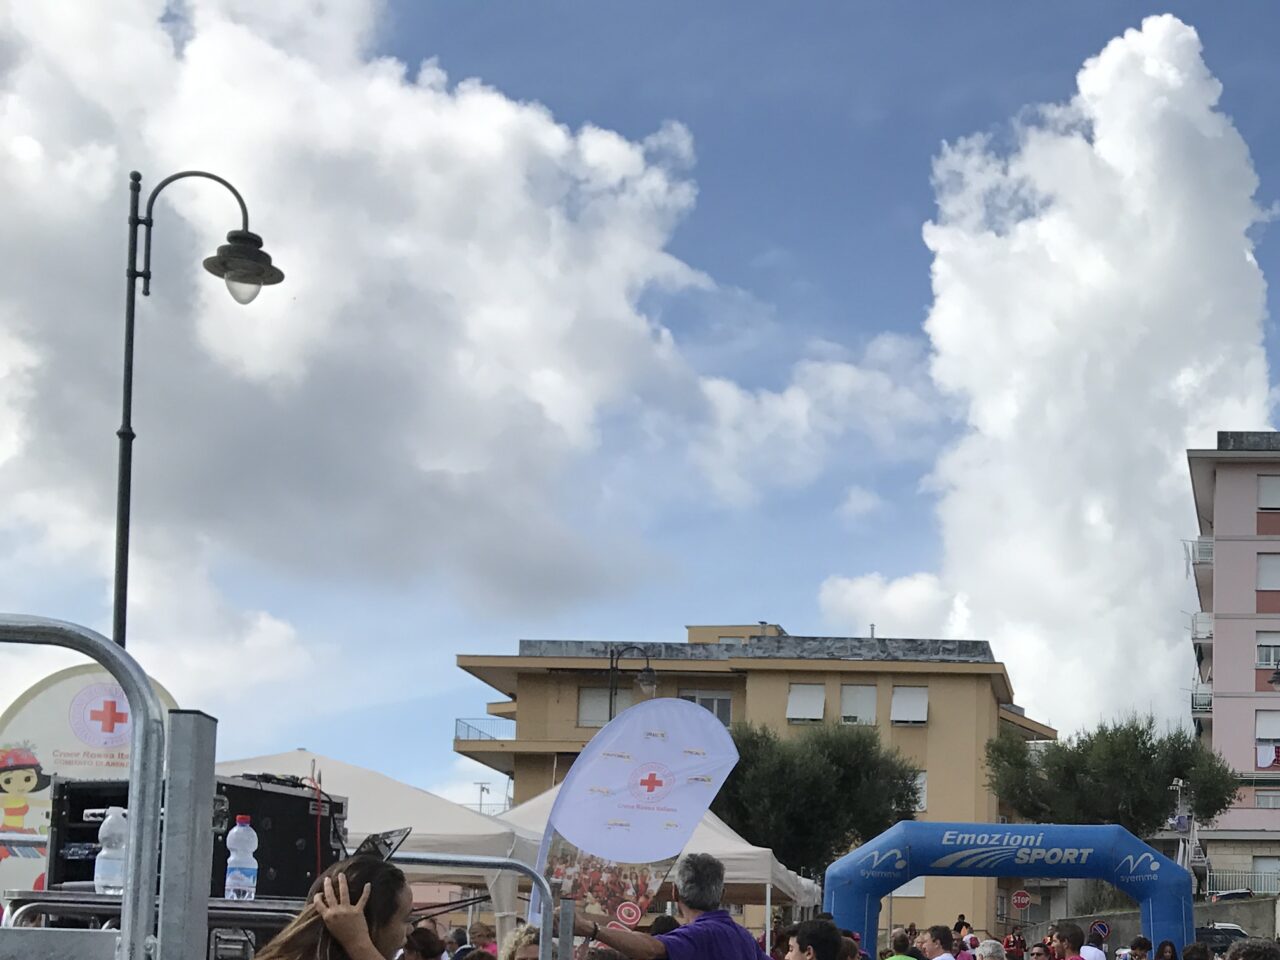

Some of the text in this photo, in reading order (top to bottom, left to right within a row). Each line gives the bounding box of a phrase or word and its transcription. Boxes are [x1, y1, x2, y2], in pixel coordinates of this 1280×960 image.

[942, 831, 1045, 846] Emozioni
[1014, 848, 1094, 864] SPORT
[1012, 896, 1030, 904] STOP
